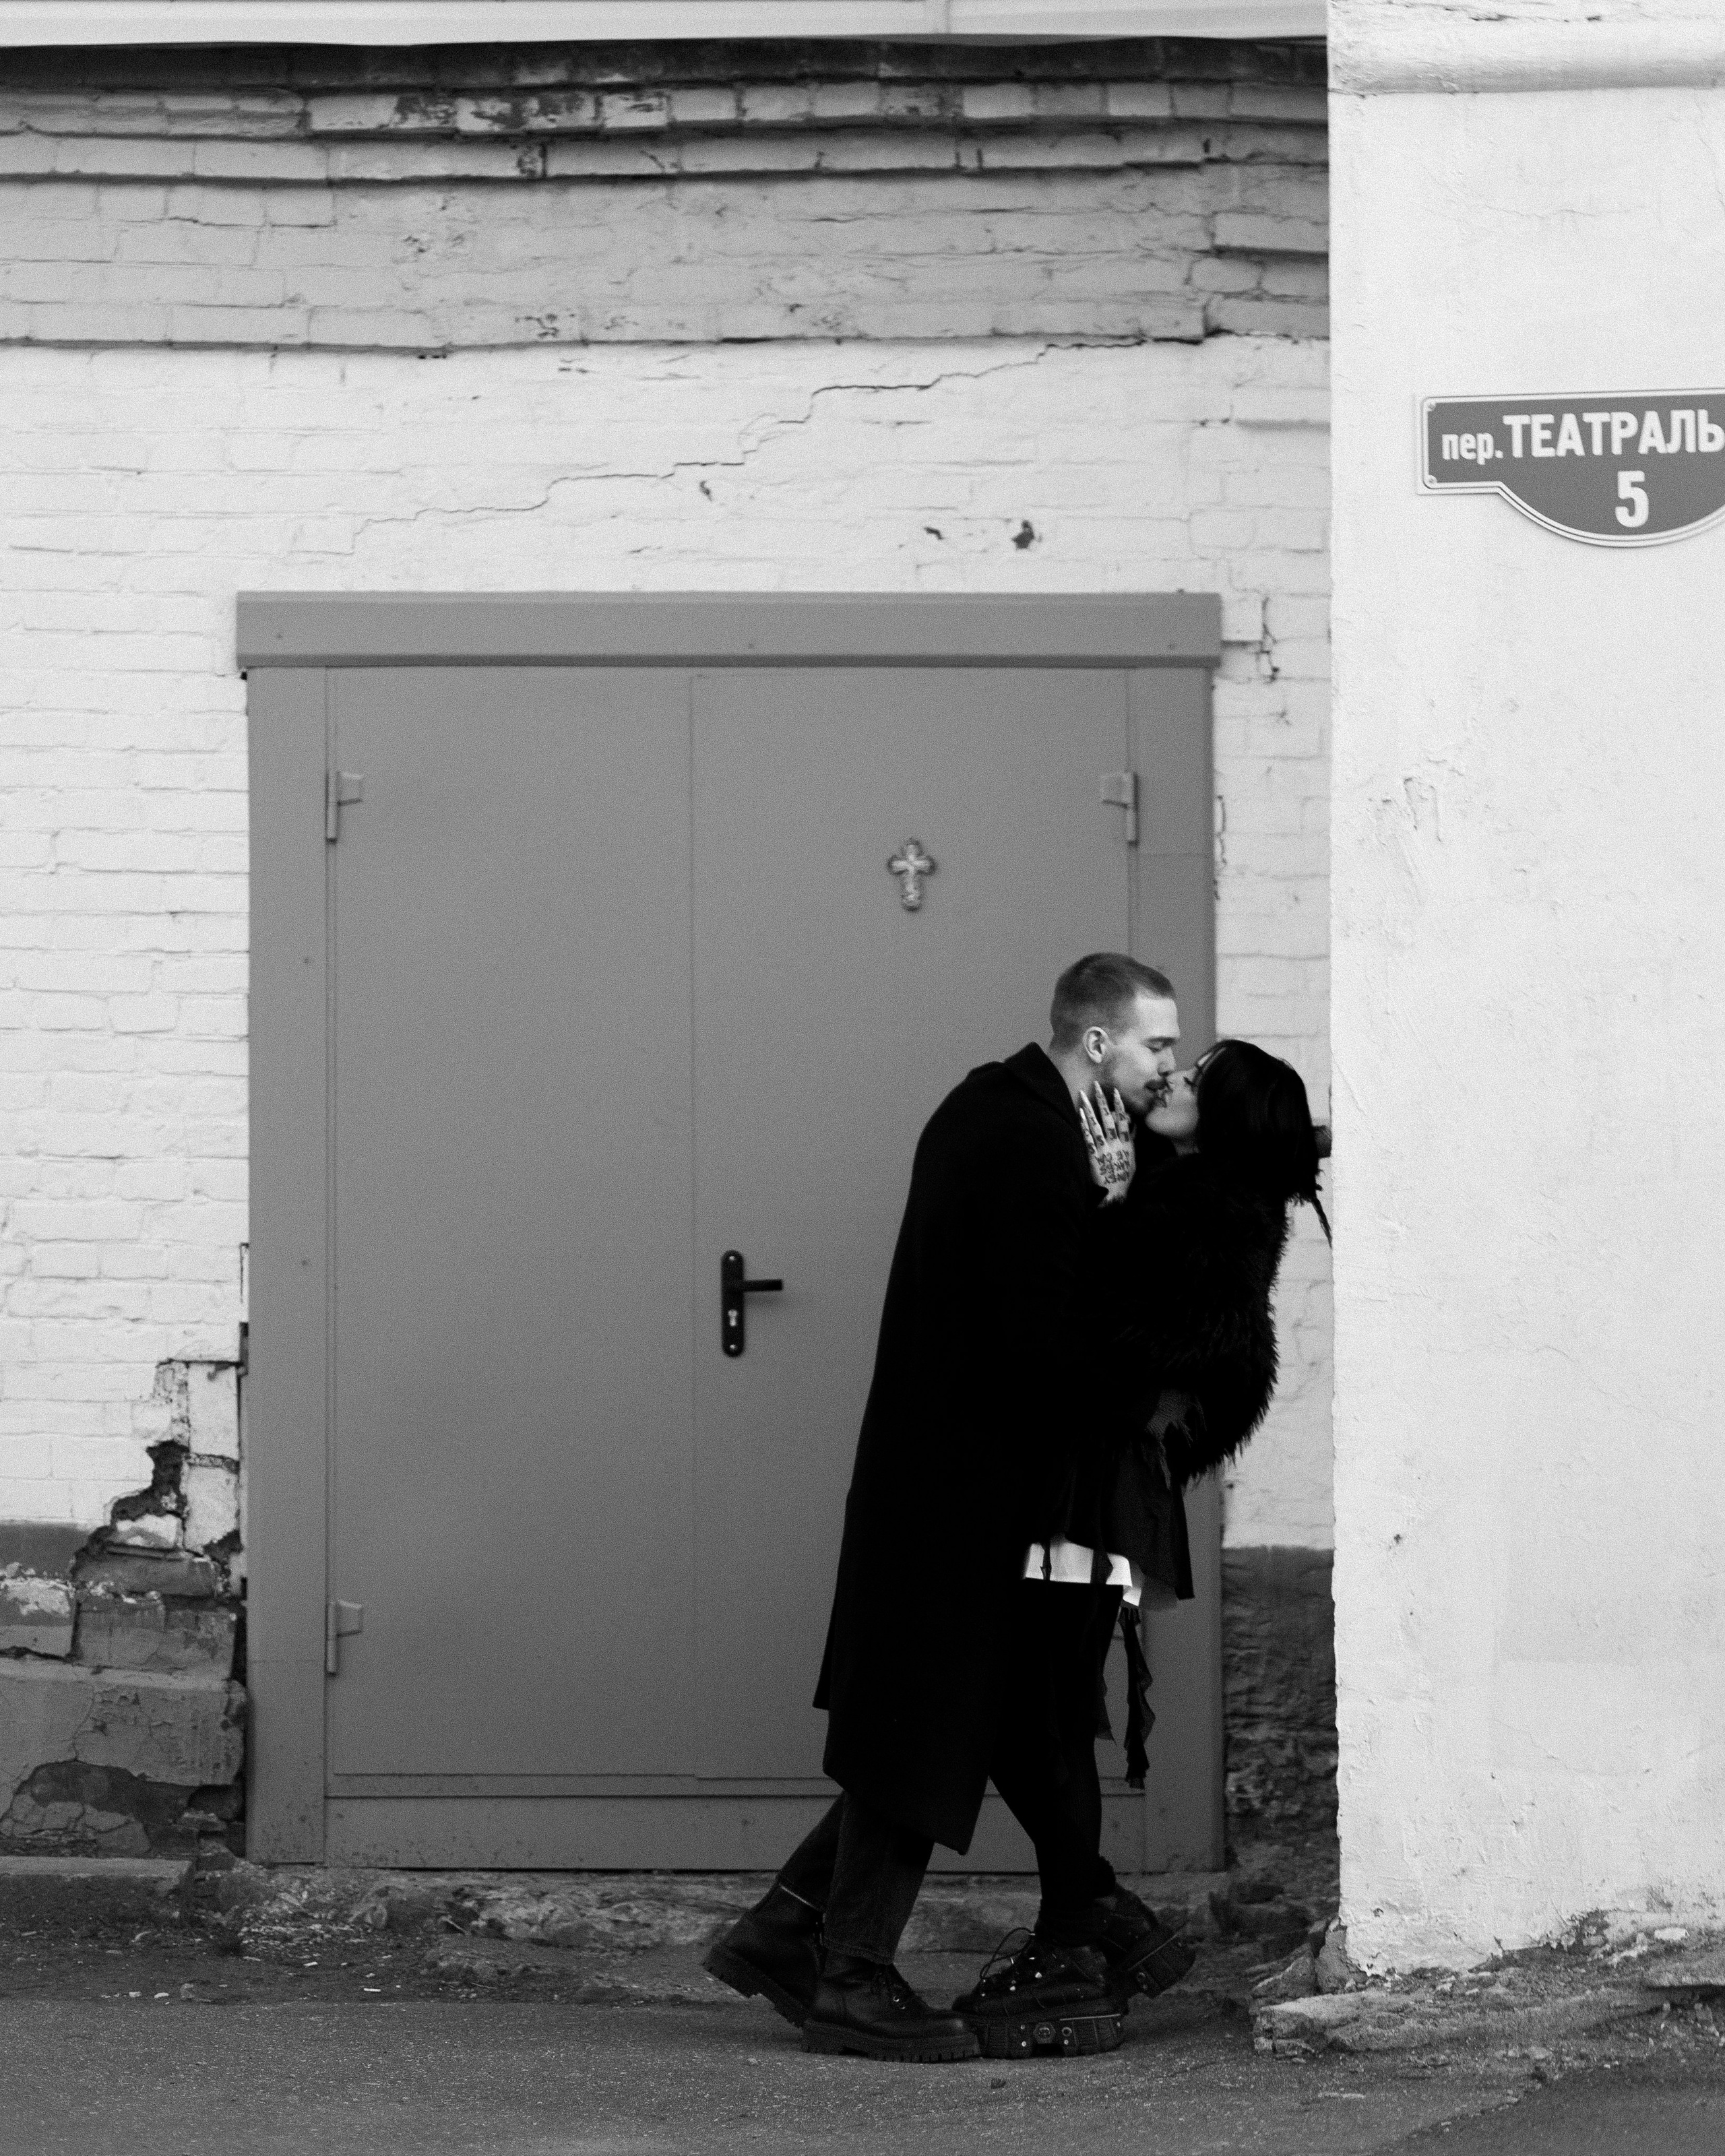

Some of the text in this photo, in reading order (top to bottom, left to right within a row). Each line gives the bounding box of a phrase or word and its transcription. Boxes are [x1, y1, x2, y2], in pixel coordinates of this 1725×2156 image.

[1441, 408, 1725, 466] пер. ТЕАТРАЛЬ
[1615, 470, 1650, 528] 5
